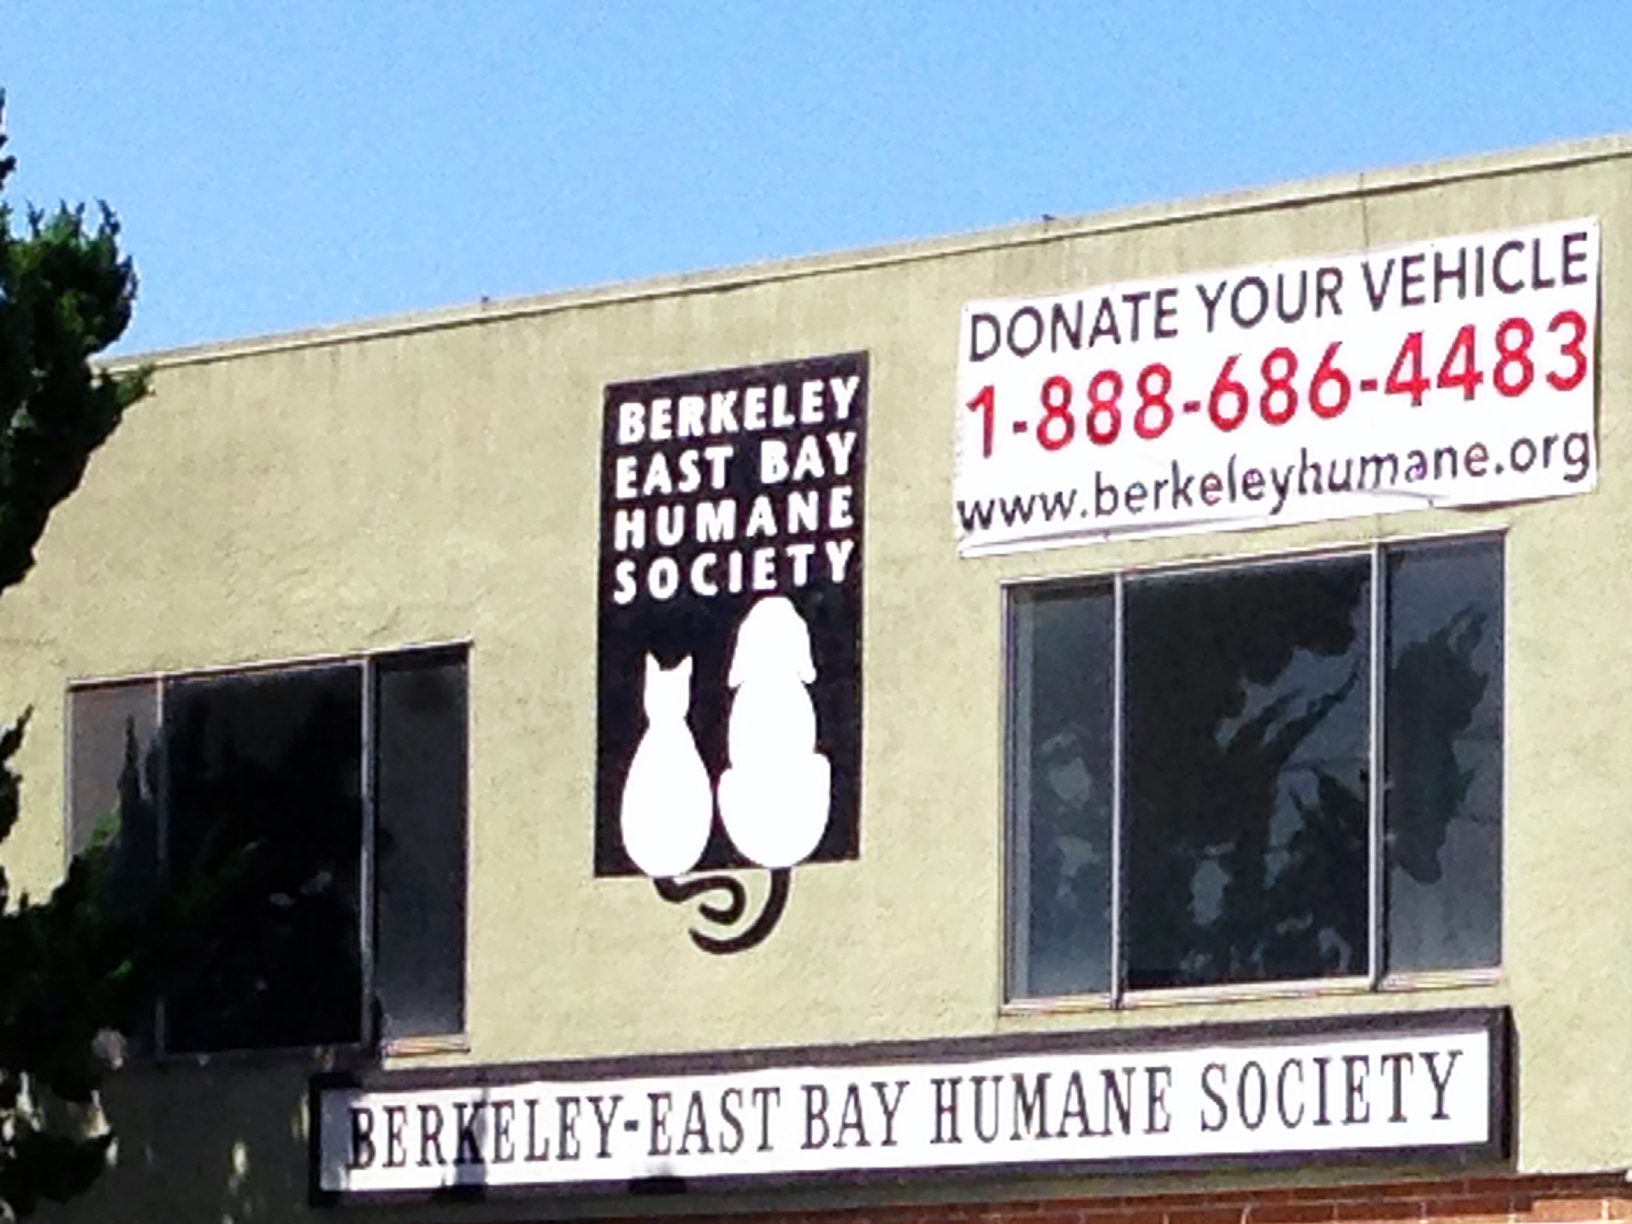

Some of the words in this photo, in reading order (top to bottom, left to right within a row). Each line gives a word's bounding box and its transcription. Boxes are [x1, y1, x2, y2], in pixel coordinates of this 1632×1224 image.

[969, 287, 1179, 363] DONATE
[1196, 266, 1344, 333] YOUR
[1360, 231, 1589, 313] VEHICLE
[616, 375, 861, 445] BERKELEY
[964, 309, 1589, 460] 1-888-686-4483
[616, 446, 734, 501] EAST
[759, 431, 858, 485] BAY
[956, 430, 1590, 534] www.berkeleyhumane.org
[613, 486, 856, 551] HUMANE
[613, 539, 856, 605] SOCIETY
[348, 1085, 781, 1171] BERKELEY-EAST
[800, 1080, 909, 1150] BAY
[930, 1066, 1173, 1144] HUMANE
[1200, 1048, 1463, 1132] SOCIETY
